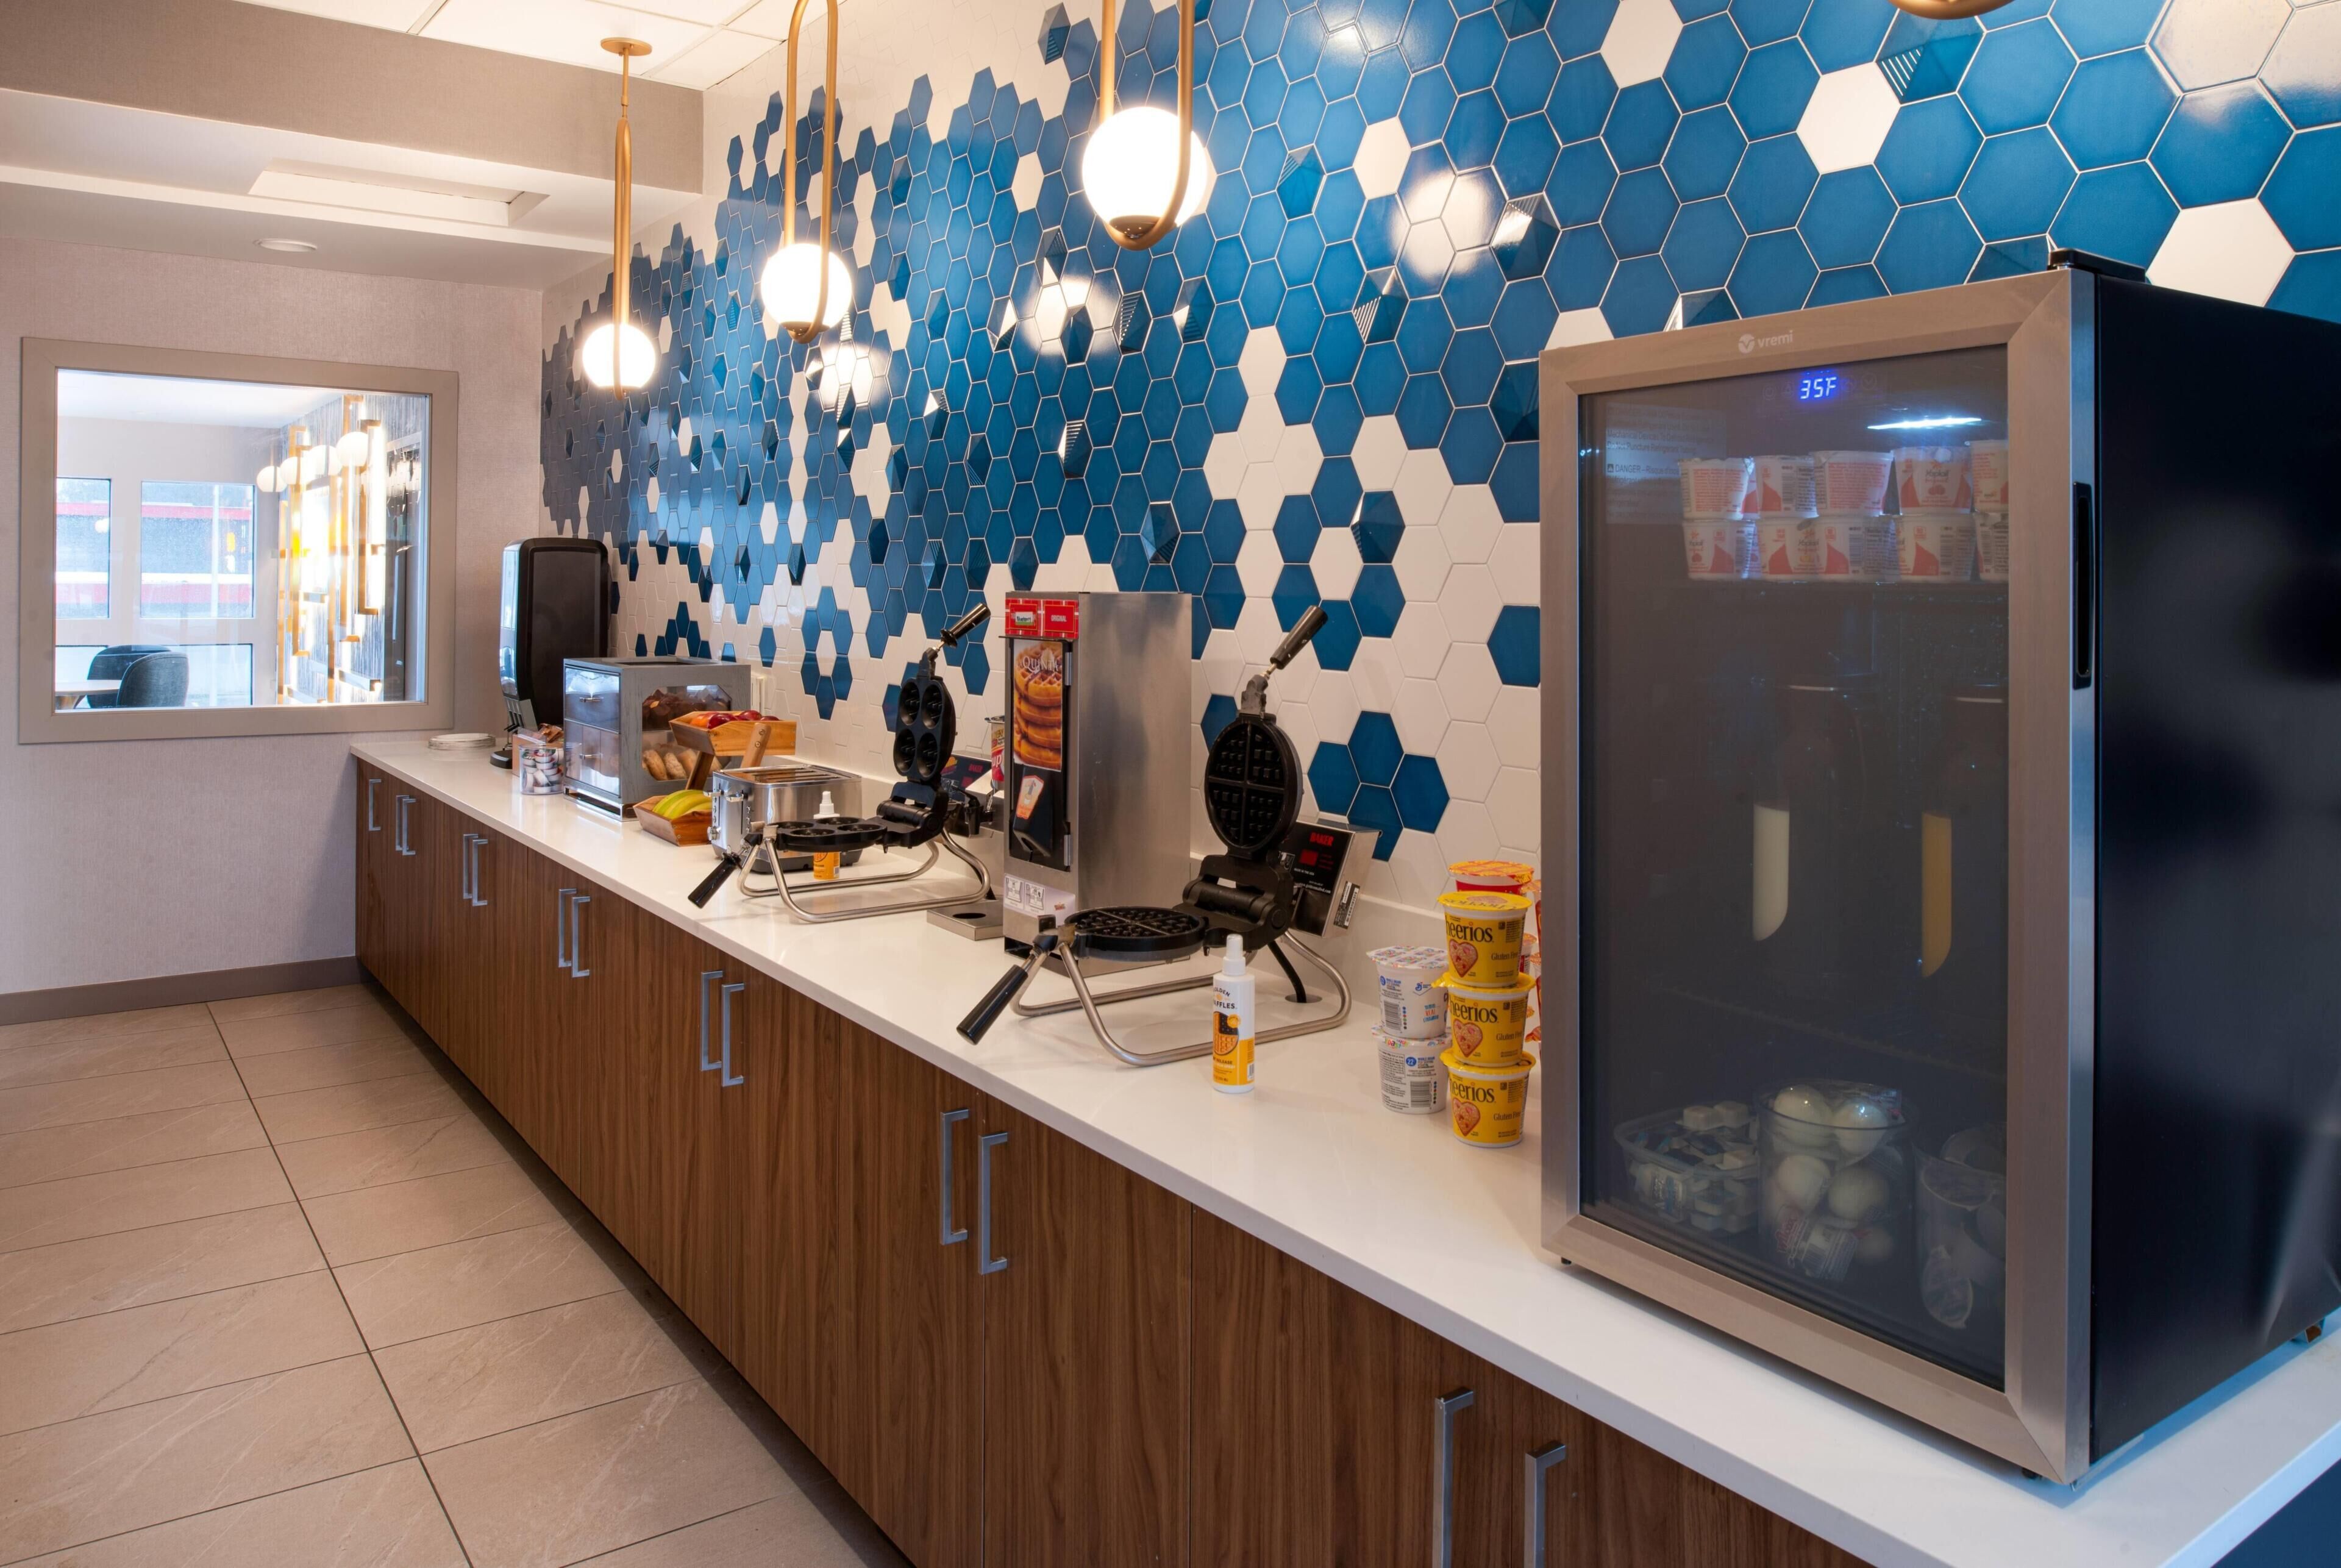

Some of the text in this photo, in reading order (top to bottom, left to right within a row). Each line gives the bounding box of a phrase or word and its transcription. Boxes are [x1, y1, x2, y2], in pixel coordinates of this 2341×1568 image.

[1757, 330, 1794, 347] vremi
[1800, 376, 1837, 399] 35F
[1615, 464, 1642, 474] DANGER
[1023, 655, 1059, 674] QUINTA
[1309, 832, 1334, 847] BAKER
[1445, 919, 1493, 943] heerios
[1491, 952, 1510, 961] Gluten
[1214, 986, 1230, 997] OLDEN
[1450, 999, 1497, 1023] heerios
[1450, 1078, 1495, 1103] heerios
